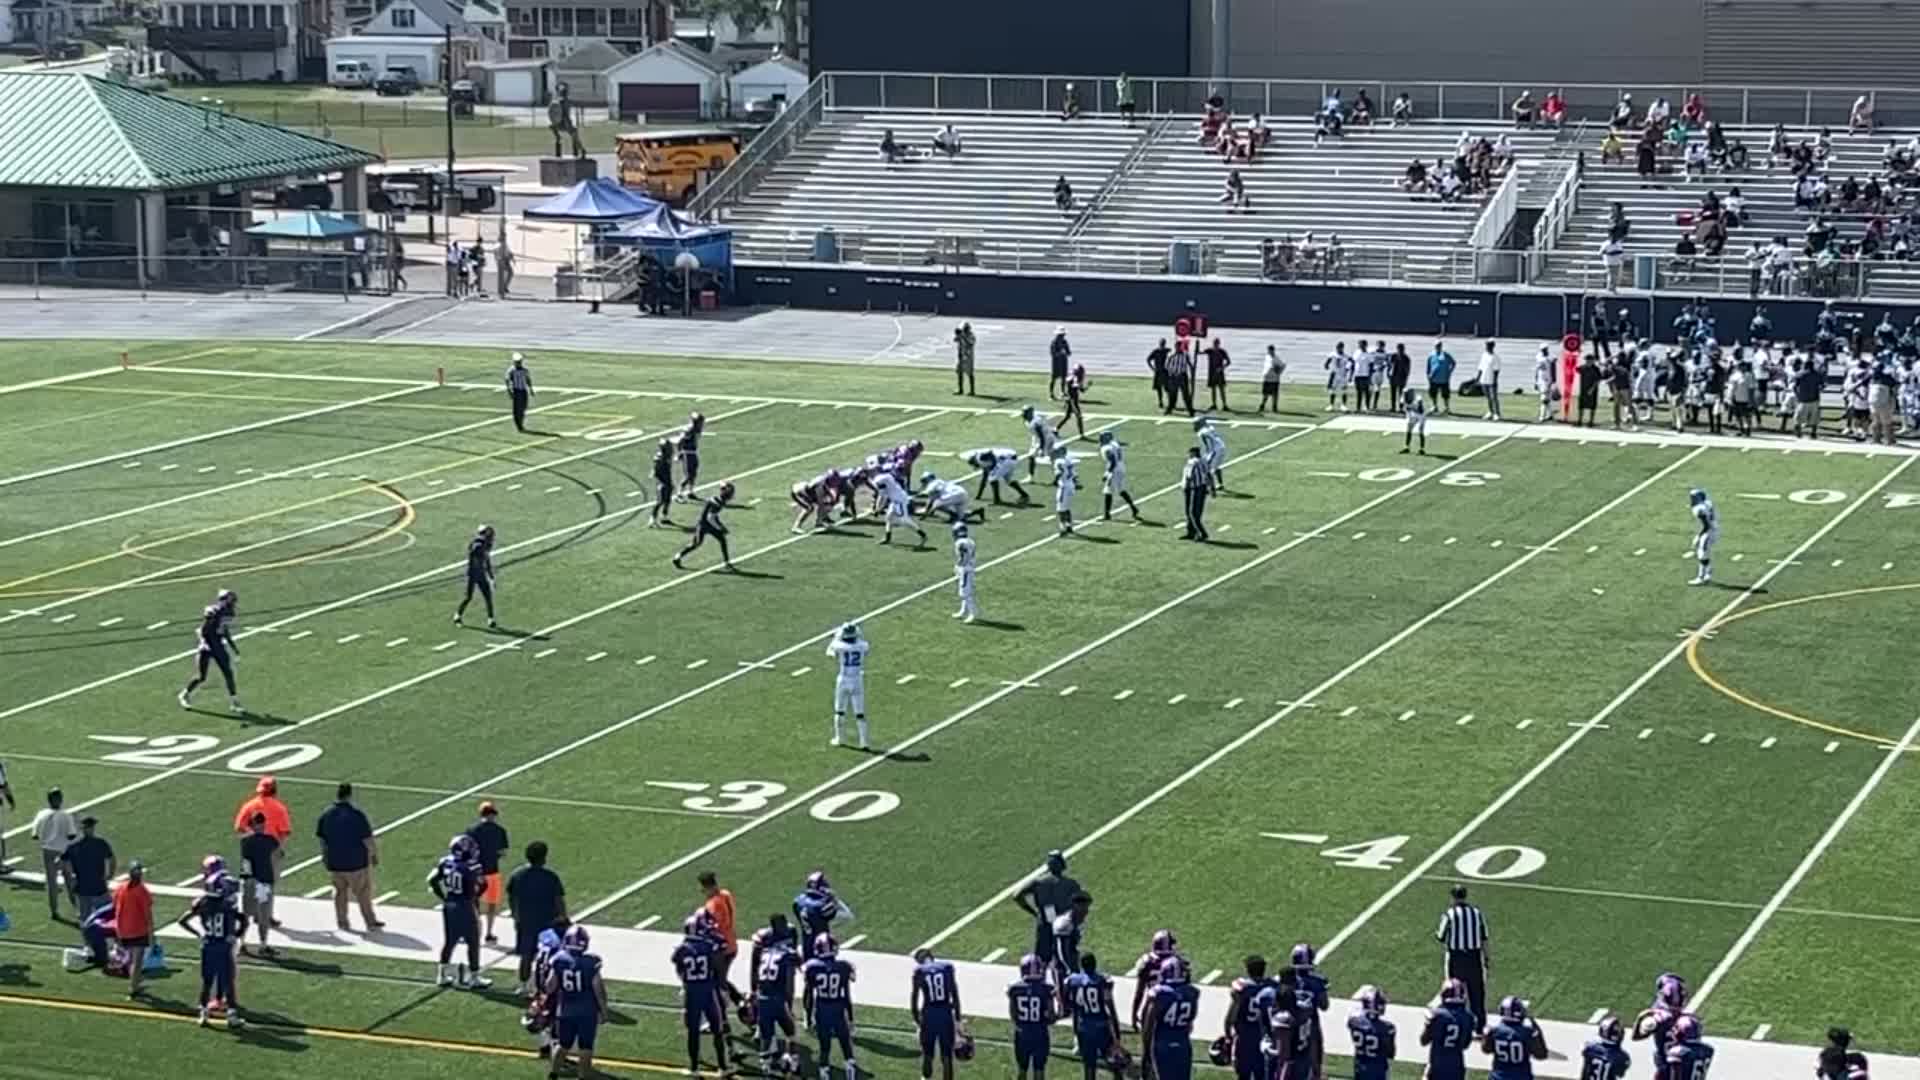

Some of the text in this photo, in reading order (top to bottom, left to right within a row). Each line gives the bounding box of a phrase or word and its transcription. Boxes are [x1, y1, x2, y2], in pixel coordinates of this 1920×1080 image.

[843, 651, 861, 667] 12
[100, 734, 323, 772] 20
[681, 780, 901, 822] 30
[1319, 835, 1547, 880] 40
[682, 955, 709, 981] 23
[758, 948, 780, 981] 25
[562, 970, 582, 992] 61
[814, 973, 841, 999] 28
[924, 972, 945, 1001] 18
[1016, 996, 1040, 1022] 58
[1075, 986, 1100, 1014] 48
[1163, 1001, 1192, 1028] 42
[1352, 1030, 1378, 1057] 22
[1444, 1024, 1460, 1048] 2
[1494, 1040, 1524, 1064] 50
[1590, 1058, 1612, 1080] 31
